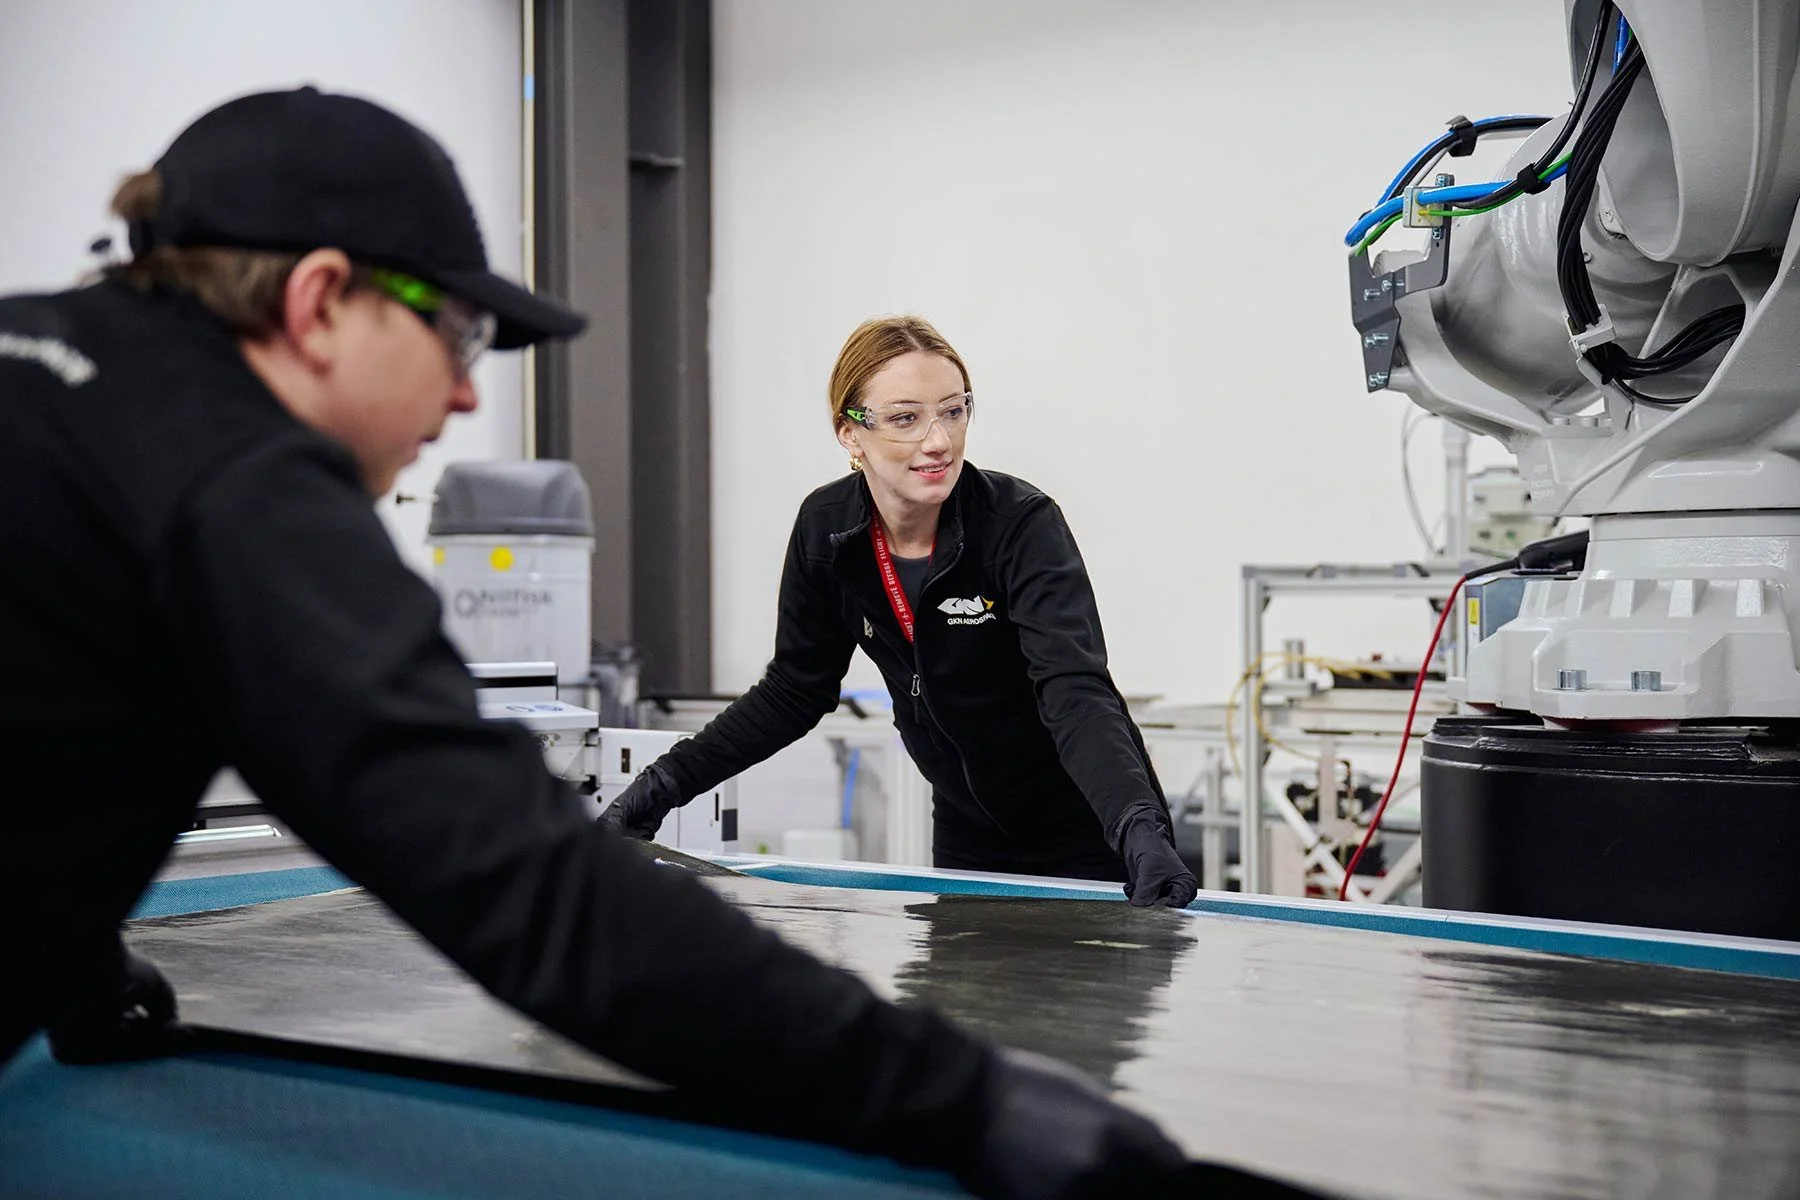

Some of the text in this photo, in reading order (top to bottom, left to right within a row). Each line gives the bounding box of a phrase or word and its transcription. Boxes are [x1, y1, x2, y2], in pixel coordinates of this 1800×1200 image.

[876, 538, 887, 560] FLIGHT
[883, 562, 896, 586] BEFORE
[890, 587, 906, 613] REMOVE
[904, 621, 914, 642] LIGHT
[947, 617, 963, 625] GKN
